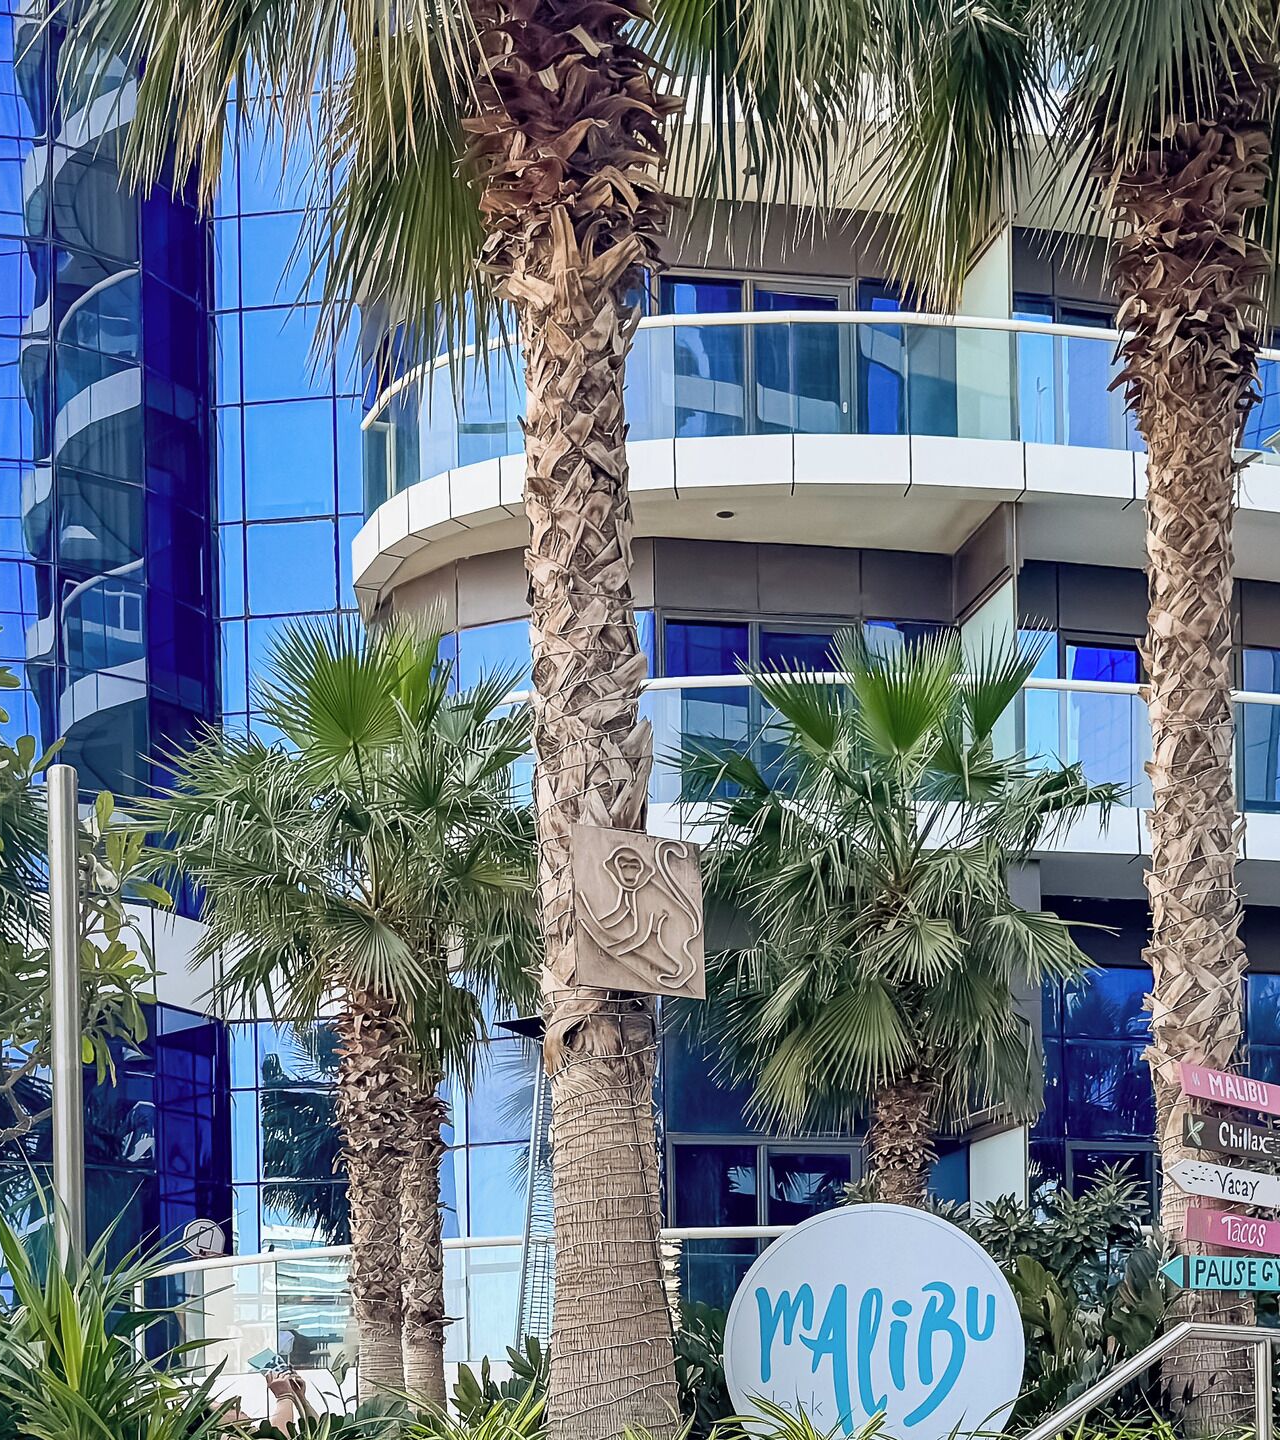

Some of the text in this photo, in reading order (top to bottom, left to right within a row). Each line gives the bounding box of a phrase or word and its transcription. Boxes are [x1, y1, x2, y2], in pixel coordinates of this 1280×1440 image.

[1207, 1072, 1269, 1107] MALIBU
[1218, 1121, 1273, 1154] Chillax
[1214, 1170, 1261, 1202] Vacay
[1194, 1259, 1257, 1287] PAUSE
